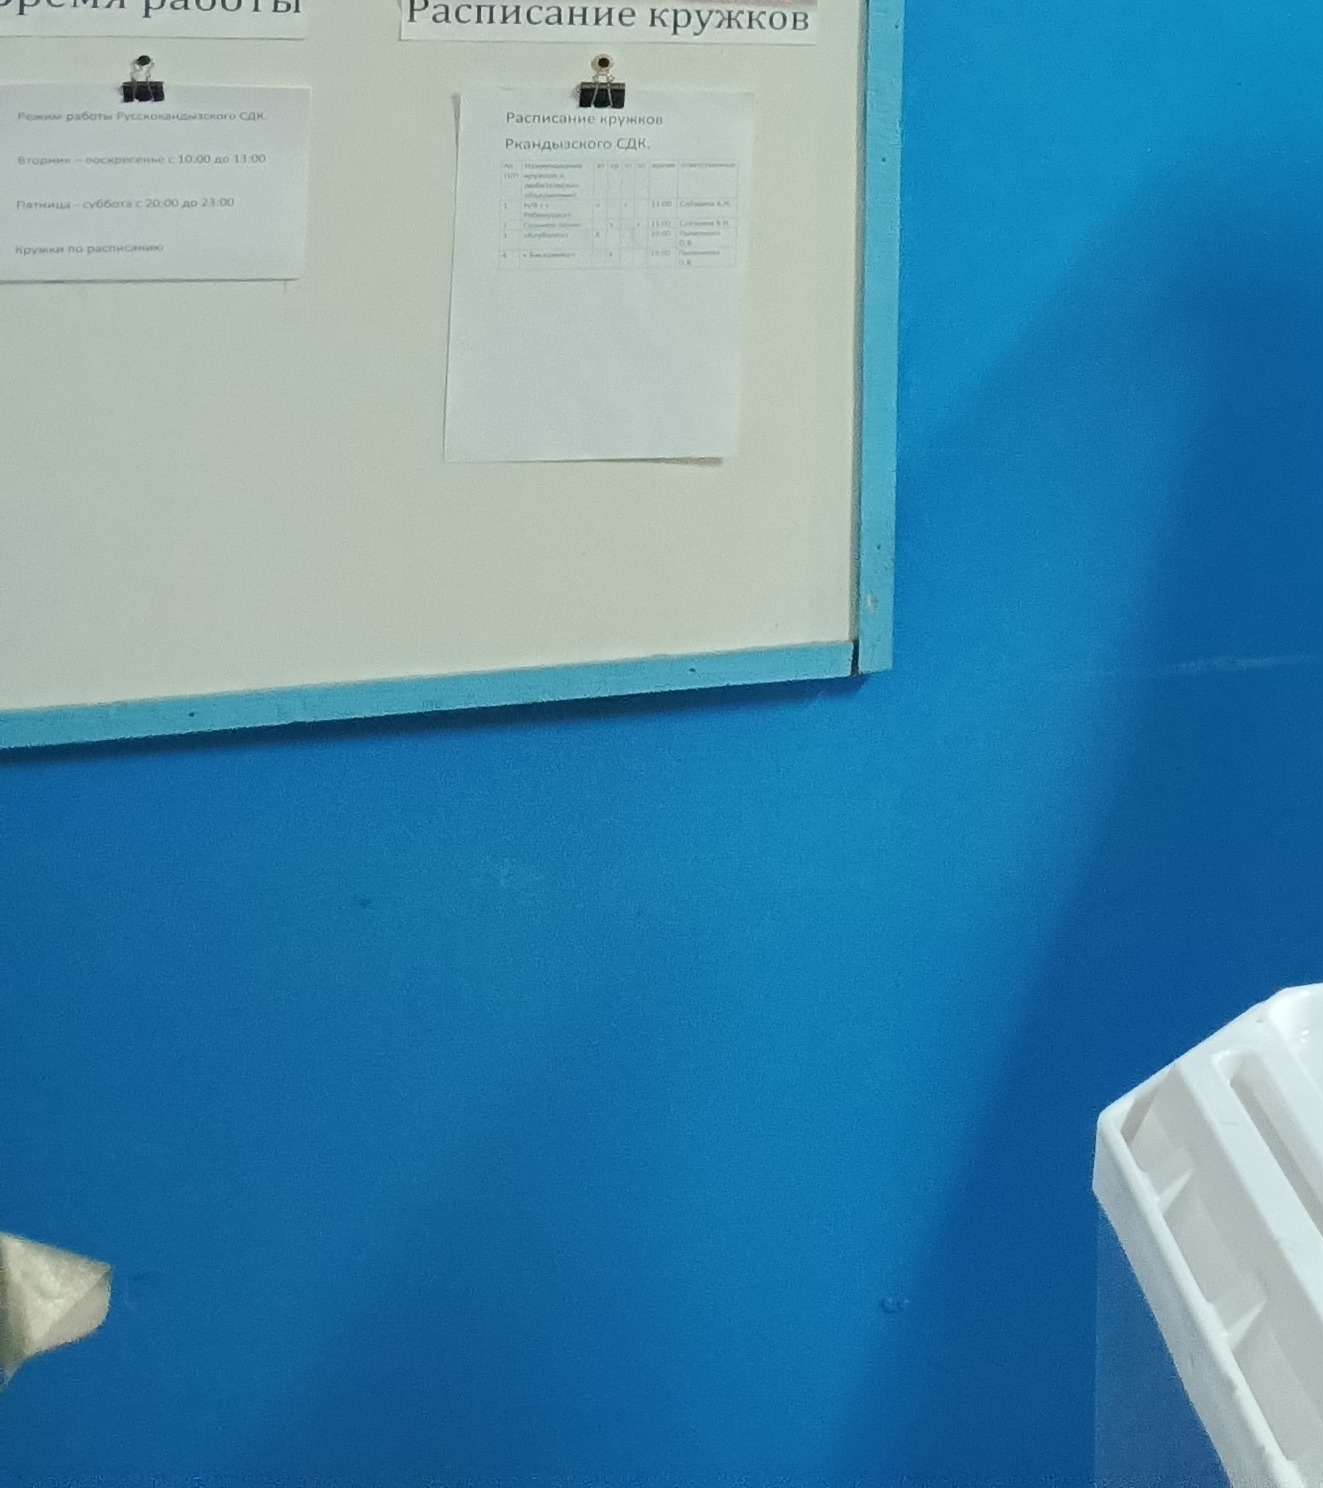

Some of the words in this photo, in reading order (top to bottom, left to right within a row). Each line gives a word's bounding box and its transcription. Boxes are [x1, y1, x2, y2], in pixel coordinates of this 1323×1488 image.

[649, 5, 811, 37] кружков
[65, 110, 113, 123] работы
[506, 111, 596, 125] Расписание
[599, 115, 664, 128] кружков
[616, 137, 651, 152] СДК.
[178, 154, 212, 164] 10:00
[213, 155, 230, 165] до
[16, 200, 71, 211] Пятница
[82, 198, 133, 210] суббота
[145, 198, 180, 209] 20:00
[181, 199, 199, 210] до
[201, 197, 235, 208] 23:00
[14, 244, 65, 257] Кружки
[67, 245, 84, 256] по
[86, 244, 165, 256] расписанию
